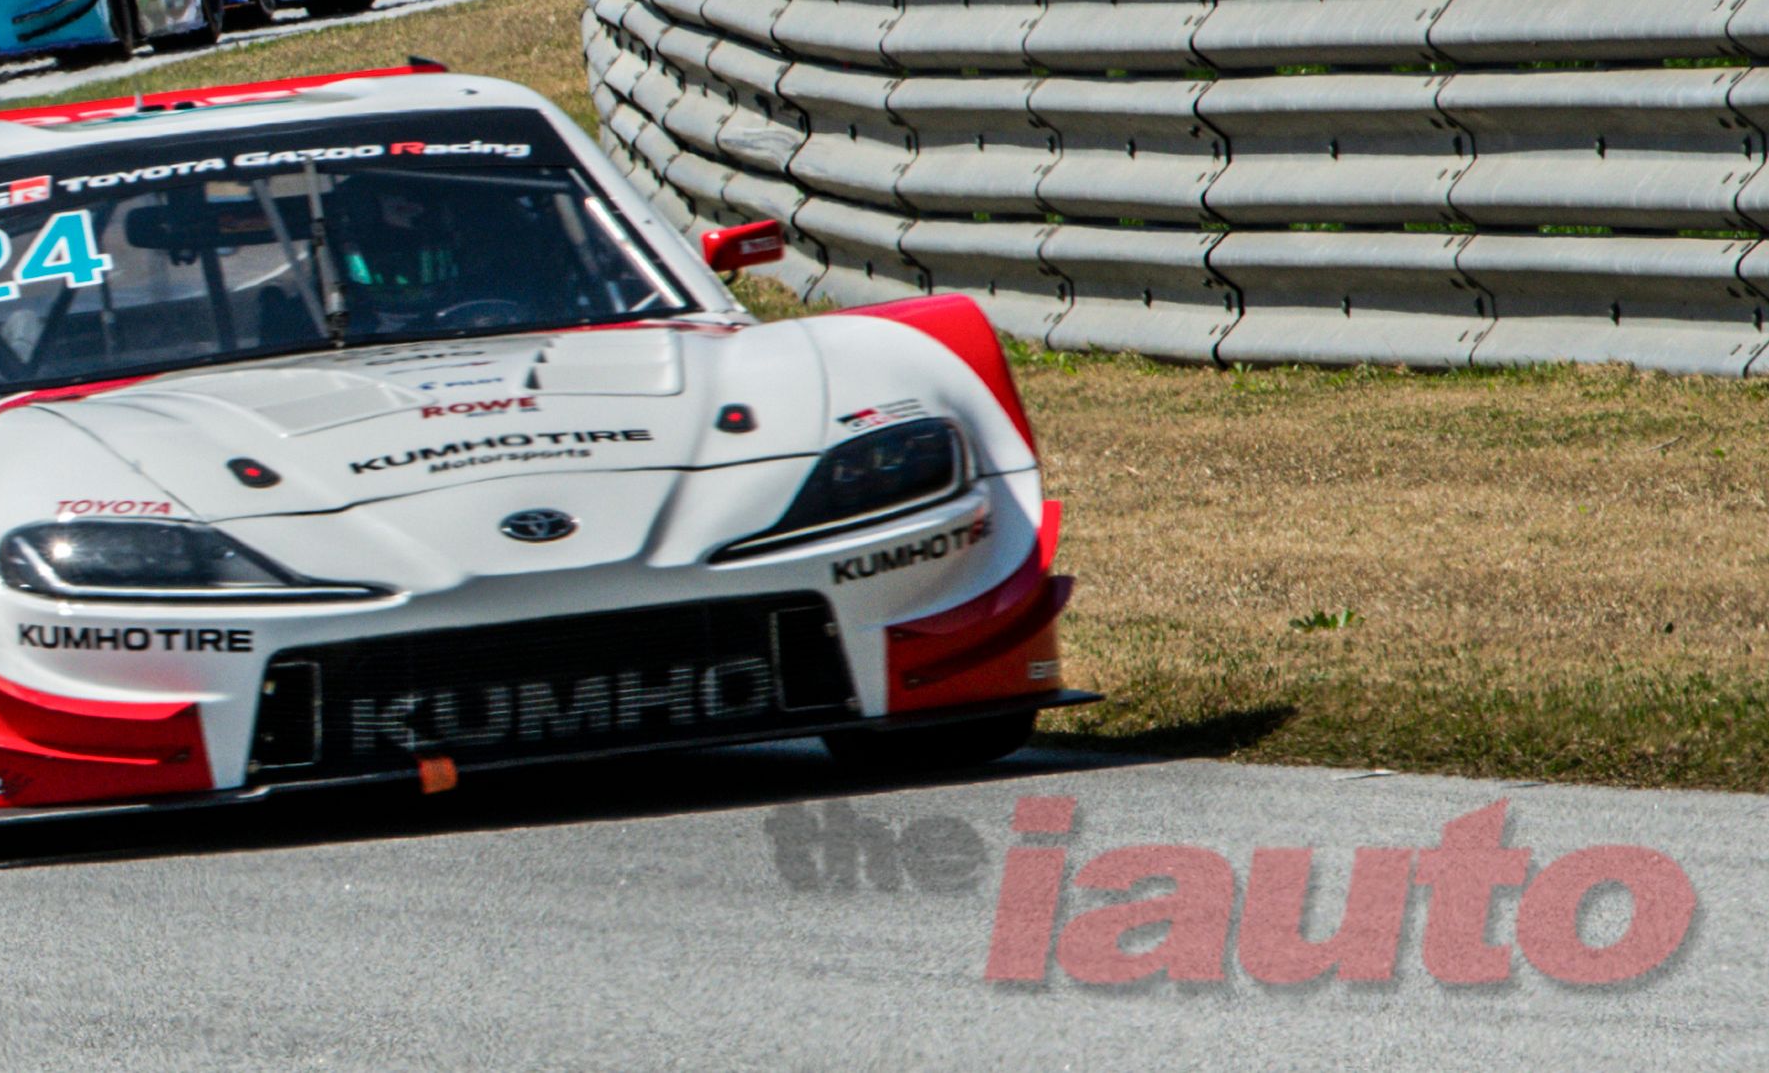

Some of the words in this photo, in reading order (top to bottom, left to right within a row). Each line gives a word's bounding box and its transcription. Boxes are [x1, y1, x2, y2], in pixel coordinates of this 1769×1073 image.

[59, 157, 226, 192] TOYOTA
[233, 144, 384, 167] GAZOO
[390, 140, 531, 159] Racing
[422, 396, 538, 419] ROWE
[429, 446, 592, 473] Motorsports
[54, 499, 173, 515] TOYOTA
[352, 657, 772, 756] KUMHO
